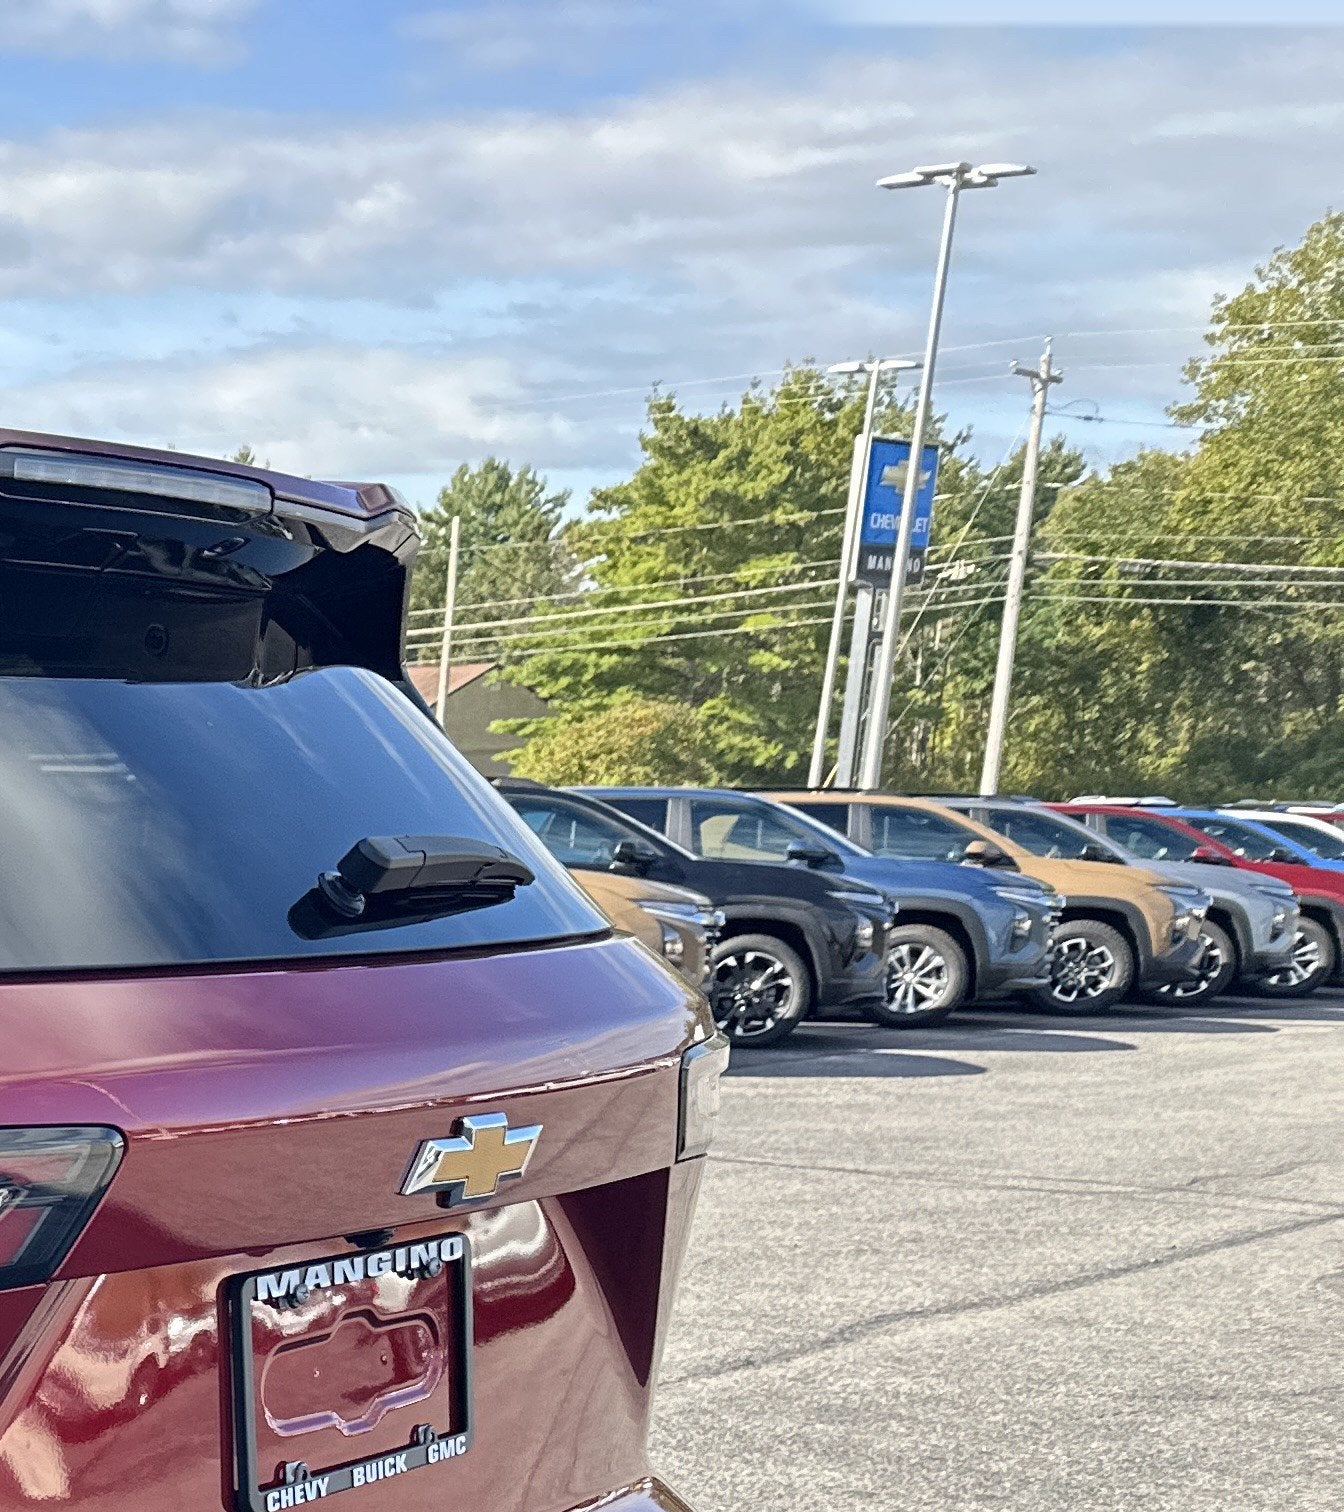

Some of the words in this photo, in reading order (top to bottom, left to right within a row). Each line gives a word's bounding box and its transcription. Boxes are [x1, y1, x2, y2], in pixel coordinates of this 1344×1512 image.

[867, 554, 920, 573] MANNO
[256, 1236, 464, 1301] MANGINO
[266, 1476, 331, 1512] CHEVY
[352, 1453, 408, 1488] BUICK
[427, 1435, 467, 1465] GMC
